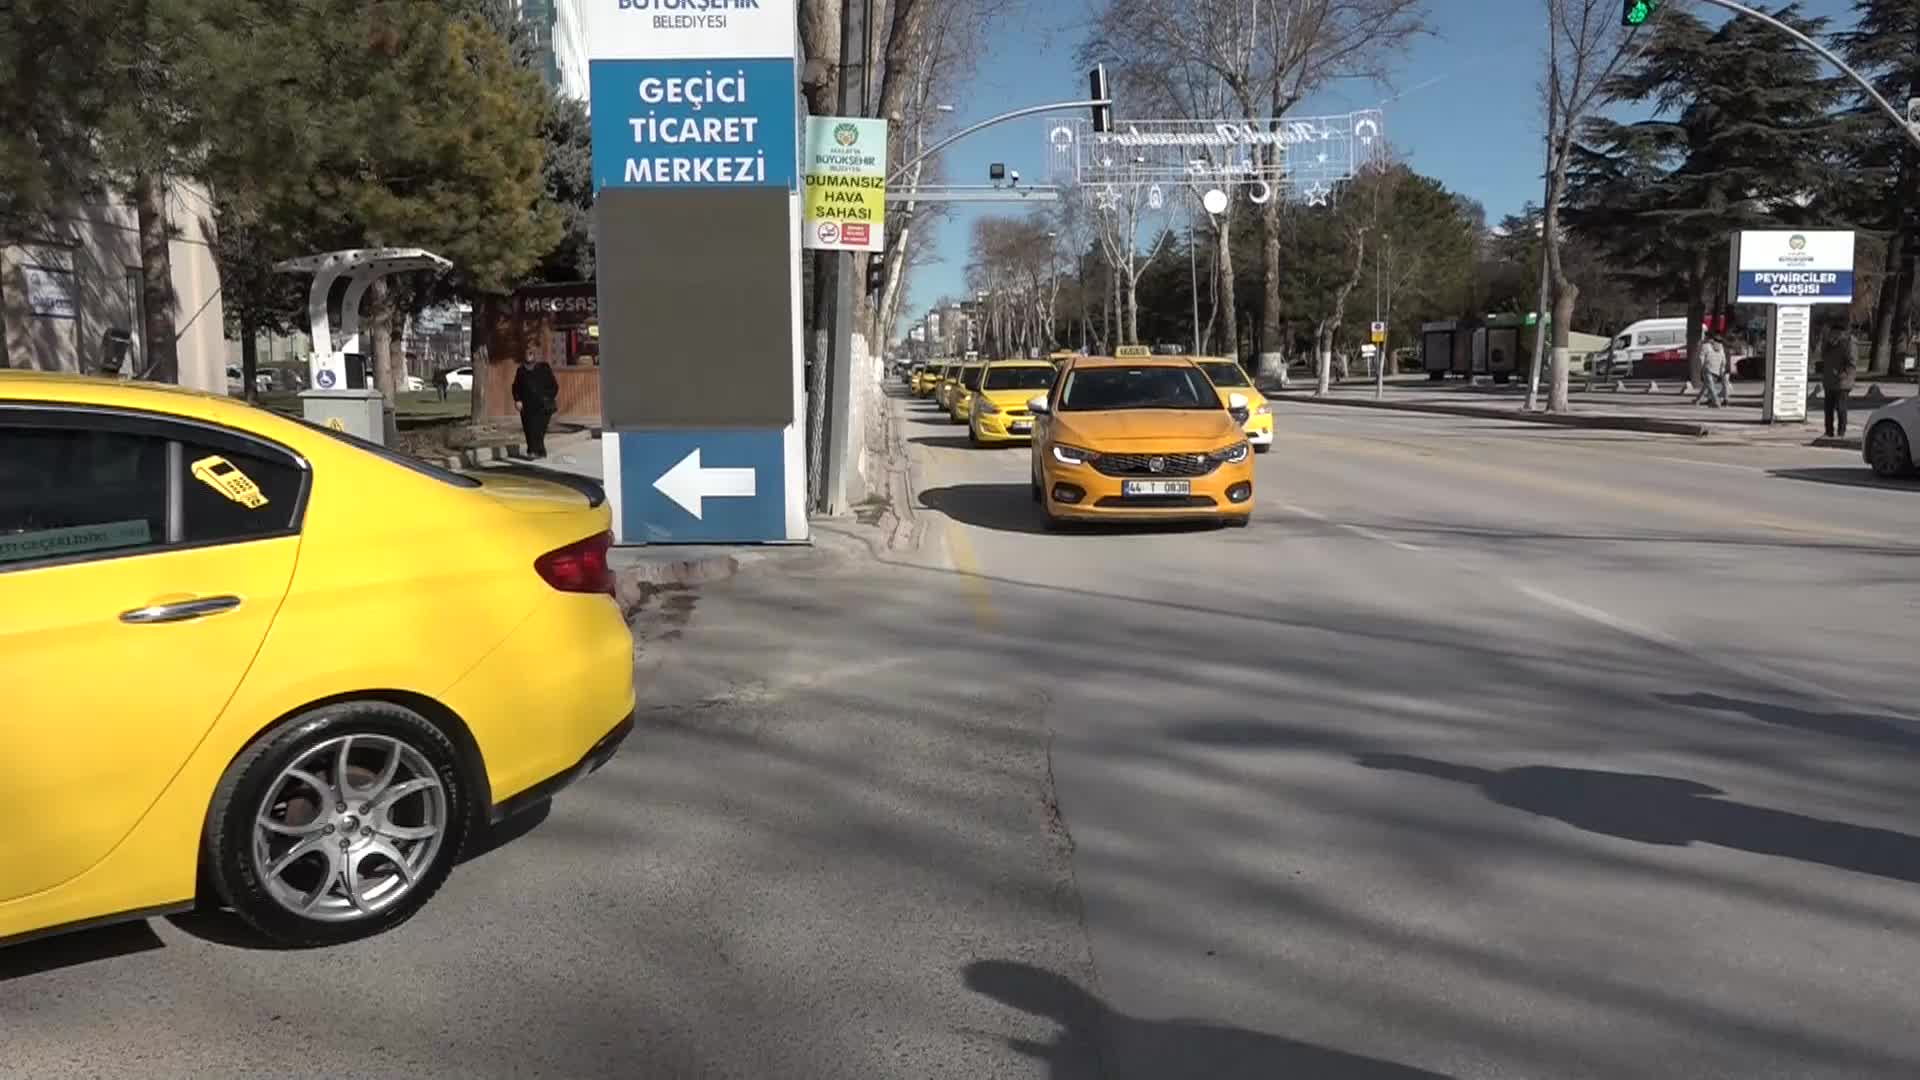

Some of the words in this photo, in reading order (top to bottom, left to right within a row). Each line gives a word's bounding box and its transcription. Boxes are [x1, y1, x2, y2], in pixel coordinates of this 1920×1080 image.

[639, 70, 745, 110] GEÇİCİ
[629, 111, 758, 143] TİCARET
[624, 150, 765, 183] MERKEZİ
[806, 175, 884, 189] DUMANSIZ
[825, 191, 864, 203] HAVA
[816, 206, 872, 220] SAHASI
[1755, 272, 1837, 284] PEYNİRCİLER
[1770, 284, 1820, 296] ÇARŞISI
[1130, 482, 1141, 492] 44
